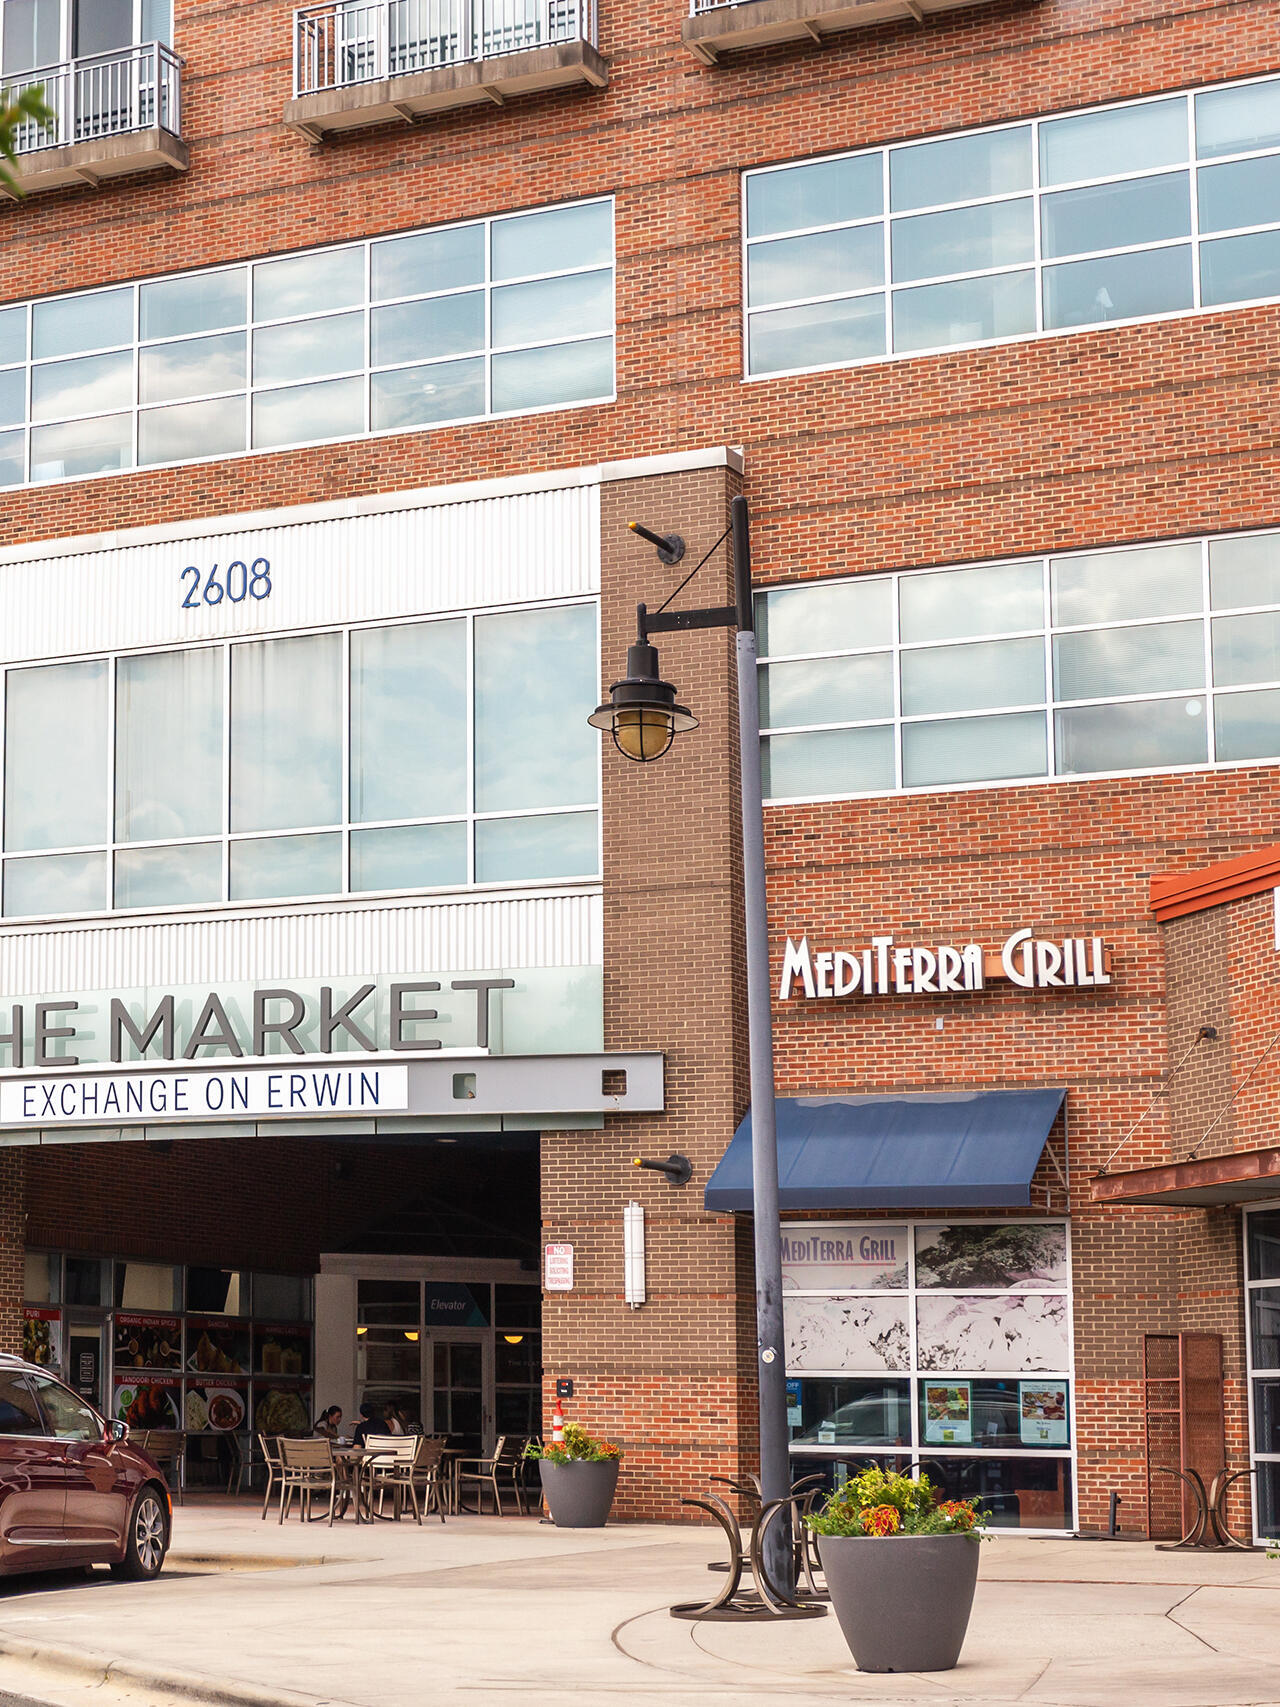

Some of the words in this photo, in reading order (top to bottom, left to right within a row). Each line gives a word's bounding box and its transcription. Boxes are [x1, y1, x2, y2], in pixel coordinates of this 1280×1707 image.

[181, 557, 272, 608] 2608
[110, 978, 515, 1062] MARKET
[22, 1078, 190, 1118] EXCHANGE
[205, 1077, 250, 1111] ON
[267, 1071, 380, 1109] ERWIN
[553, 1246, 566, 1255] NO
[431, 1299, 466, 1310] Elevator
[26, 1310, 40, 1318] PURI
[120, 1316, 142, 1325] ORGANIC
[143, 1318, 160, 1326] INDIAN
[122, 1375, 150, 1384] TANDOORI
[151, 1377, 174, 1385] CHICKEN
[195, 1378, 214, 1386] BUTTER
